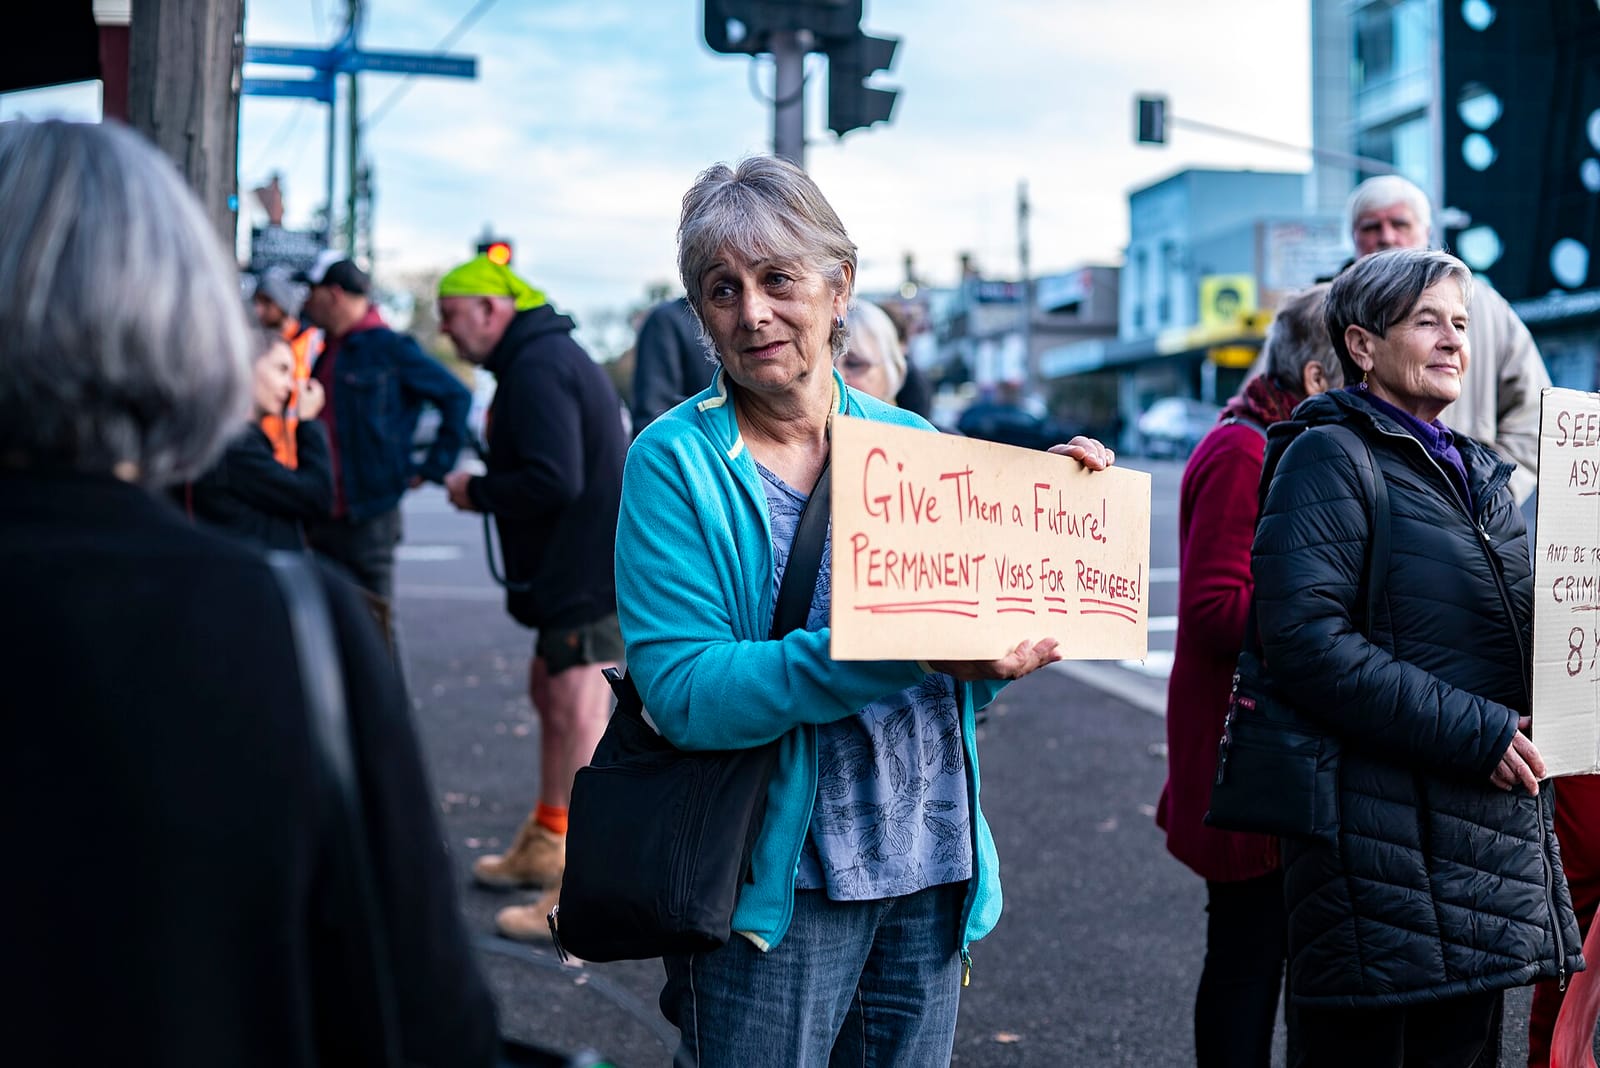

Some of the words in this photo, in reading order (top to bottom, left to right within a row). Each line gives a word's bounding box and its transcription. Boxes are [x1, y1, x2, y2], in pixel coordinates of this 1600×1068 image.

[1556, 410, 1600, 448] SEE
[864, 448, 940, 525] Give
[940, 464, 1003, 526] Them
[1011, 504, 1024, 527] a
[1033, 482, 1107, 544] Future!
[850, 532, 986, 593] PERMANENT
[994, 553, 1034, 593] VISAS
[1039, 557, 1065, 592] FOR
[1075, 559, 1142, 604] REFUGEES!
[1547, 544, 1568, 562] AND
[1573, 545, 1586, 563] BE
[1552, 575, 1600, 603] CRIMI
[1567, 626, 1585, 677] 8
